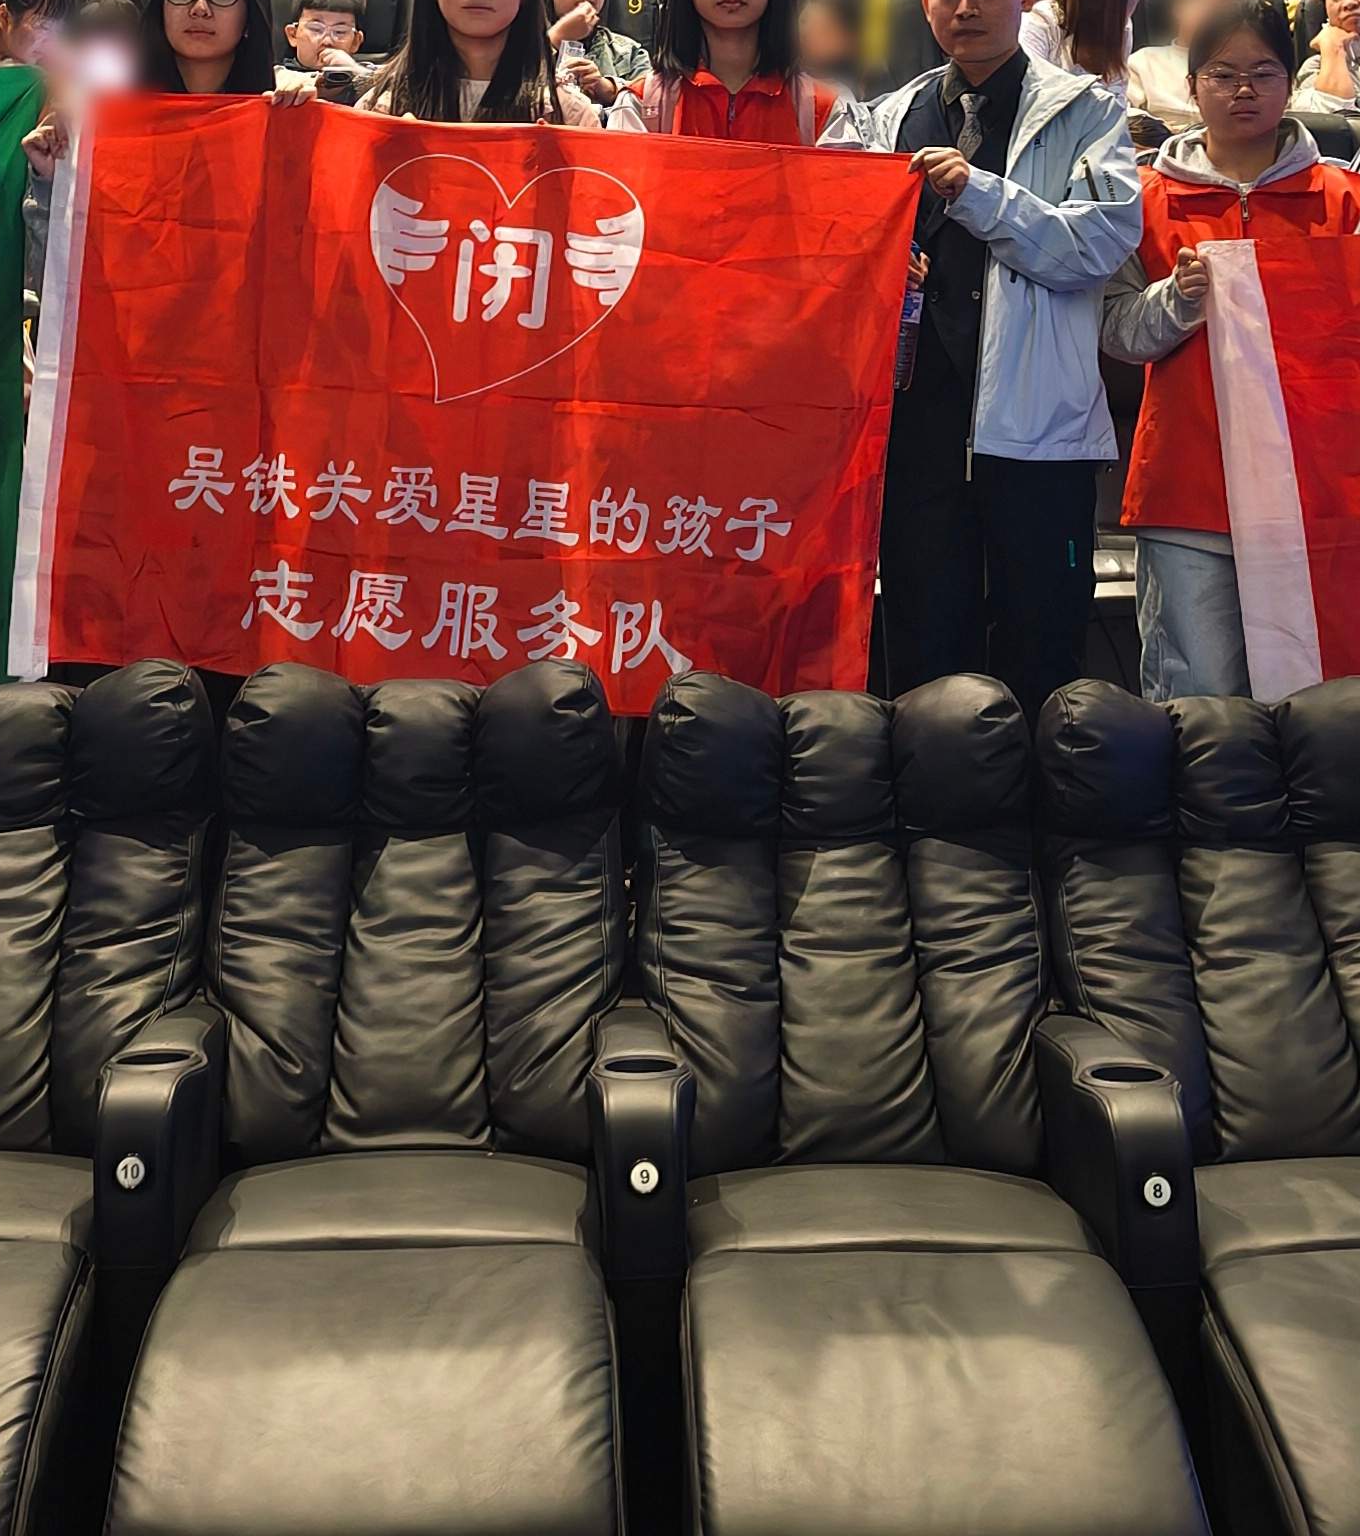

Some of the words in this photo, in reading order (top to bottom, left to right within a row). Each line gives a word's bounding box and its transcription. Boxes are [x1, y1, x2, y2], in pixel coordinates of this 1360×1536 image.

[168, 444, 793, 563] 吴铁关爱星星的孩子
[241, 559, 693, 676] 志愿服务队
[120, 1162, 140, 1182] 10
[639, 1168, 650, 1187] 9
[1152, 1181, 1163, 1201] 8
